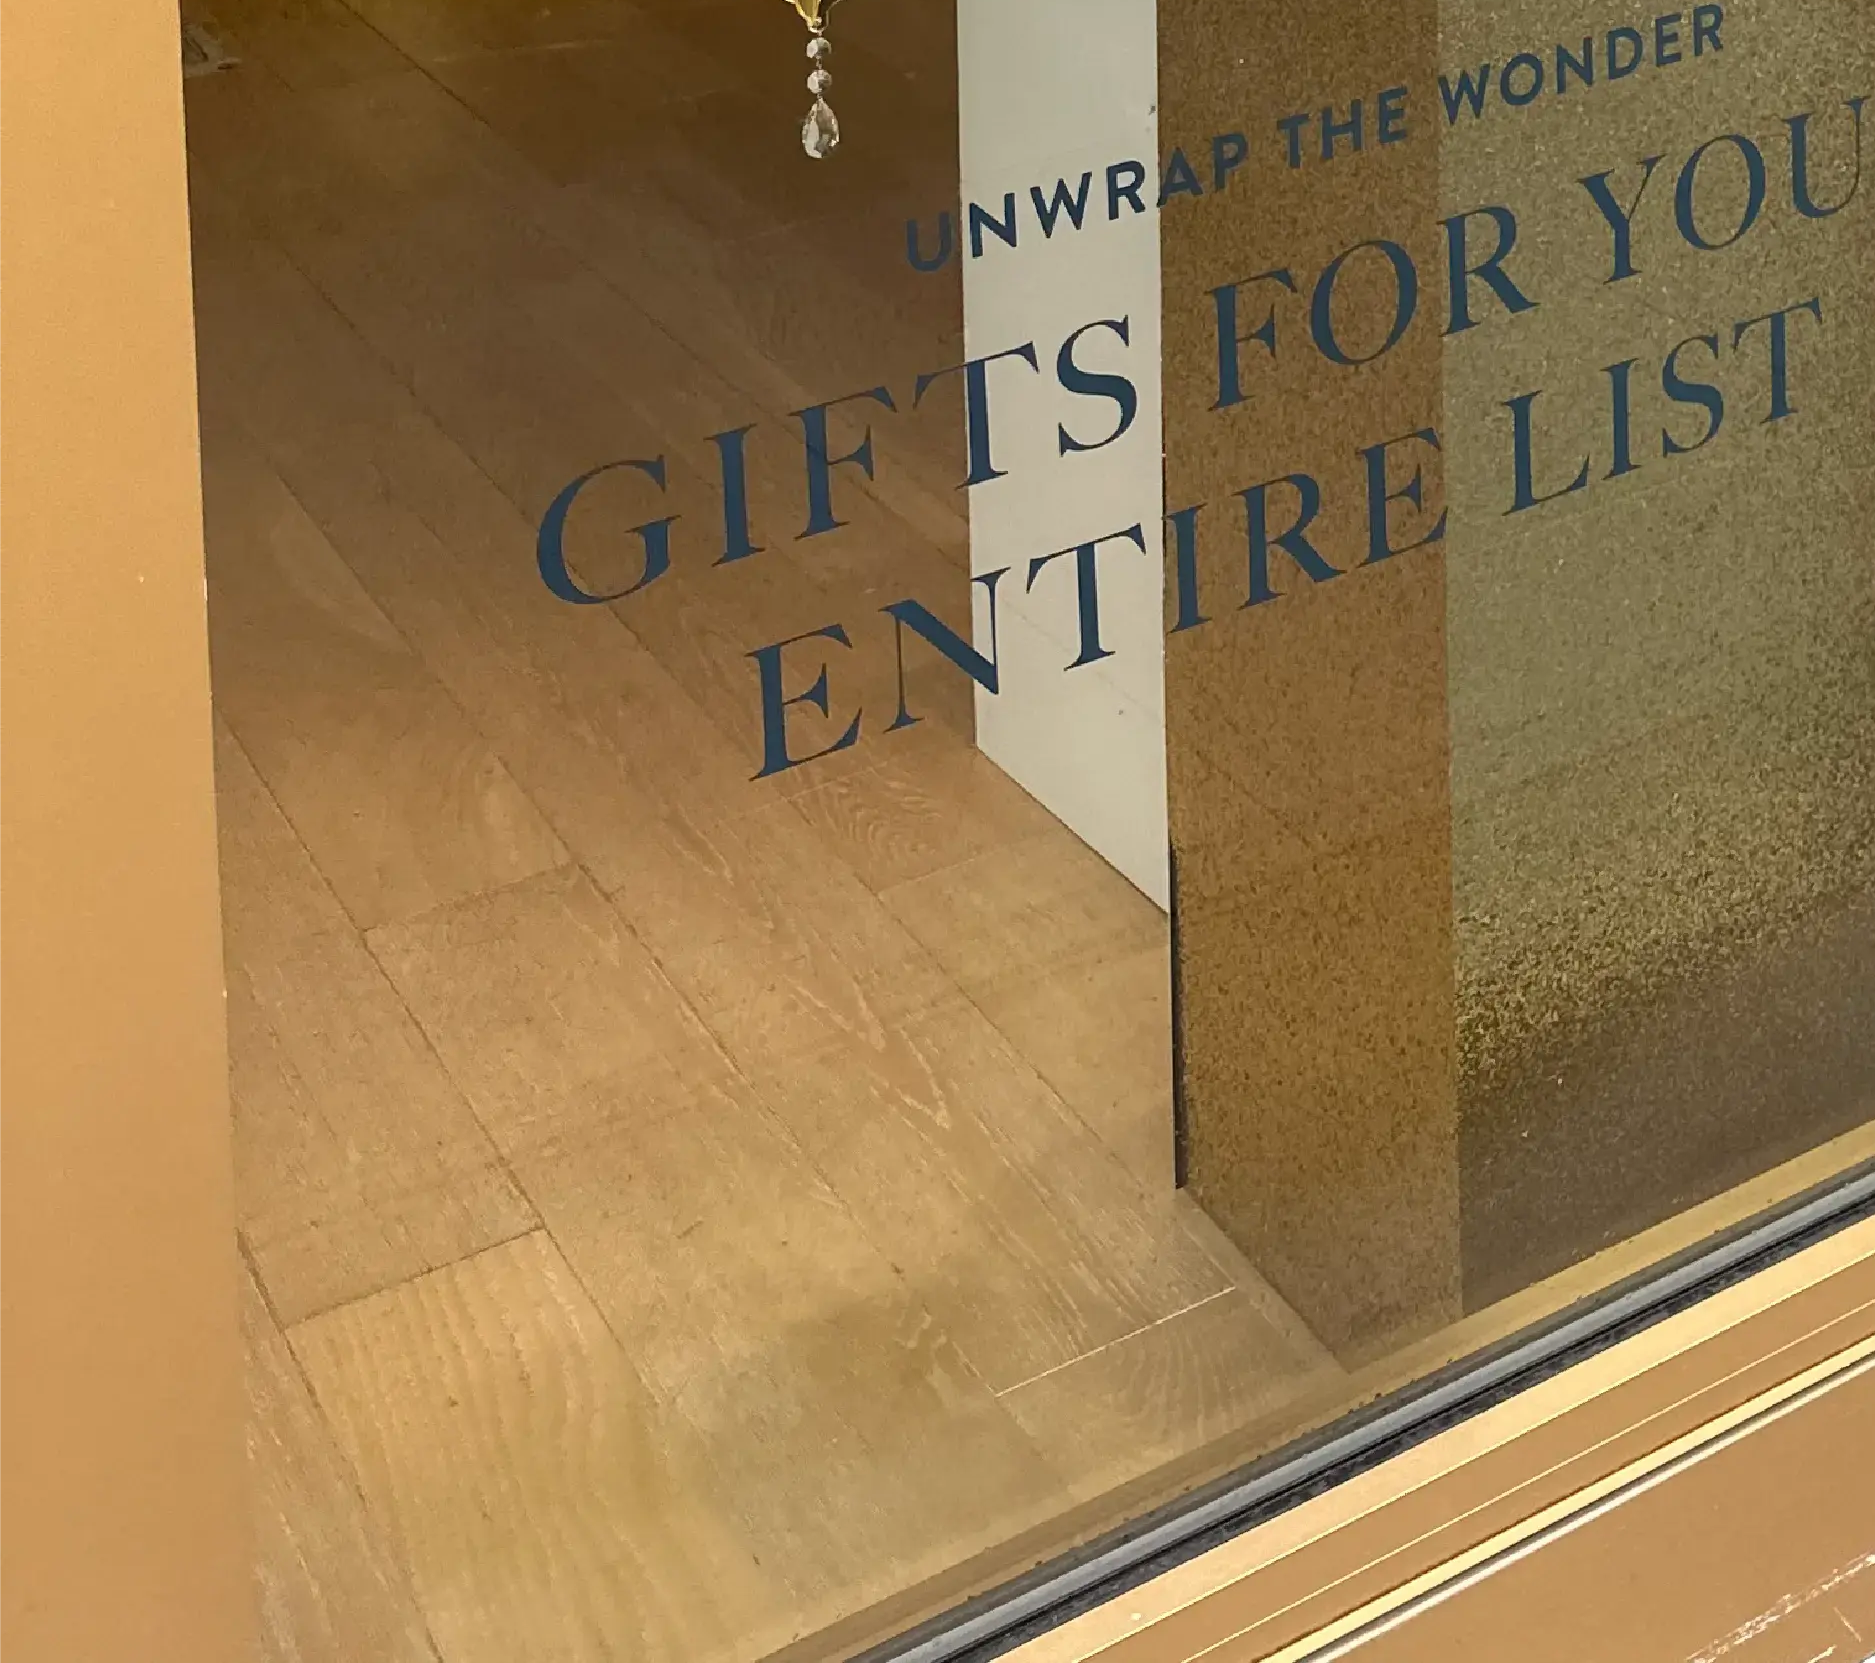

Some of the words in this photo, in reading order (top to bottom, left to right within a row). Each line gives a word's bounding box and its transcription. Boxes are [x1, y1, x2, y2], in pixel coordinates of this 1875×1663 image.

[905, 132, 1248, 272] UNWRAP
[1277, 86, 1408, 169] THE
[1438, 4, 1726, 126] WONDER
[535, 316, 1140, 606] GIFTS
[1208, 204, 1539, 411] FOR
[747, 428, 1449, 781] ENTIRE
[1501, 299, 1823, 516] LIST
